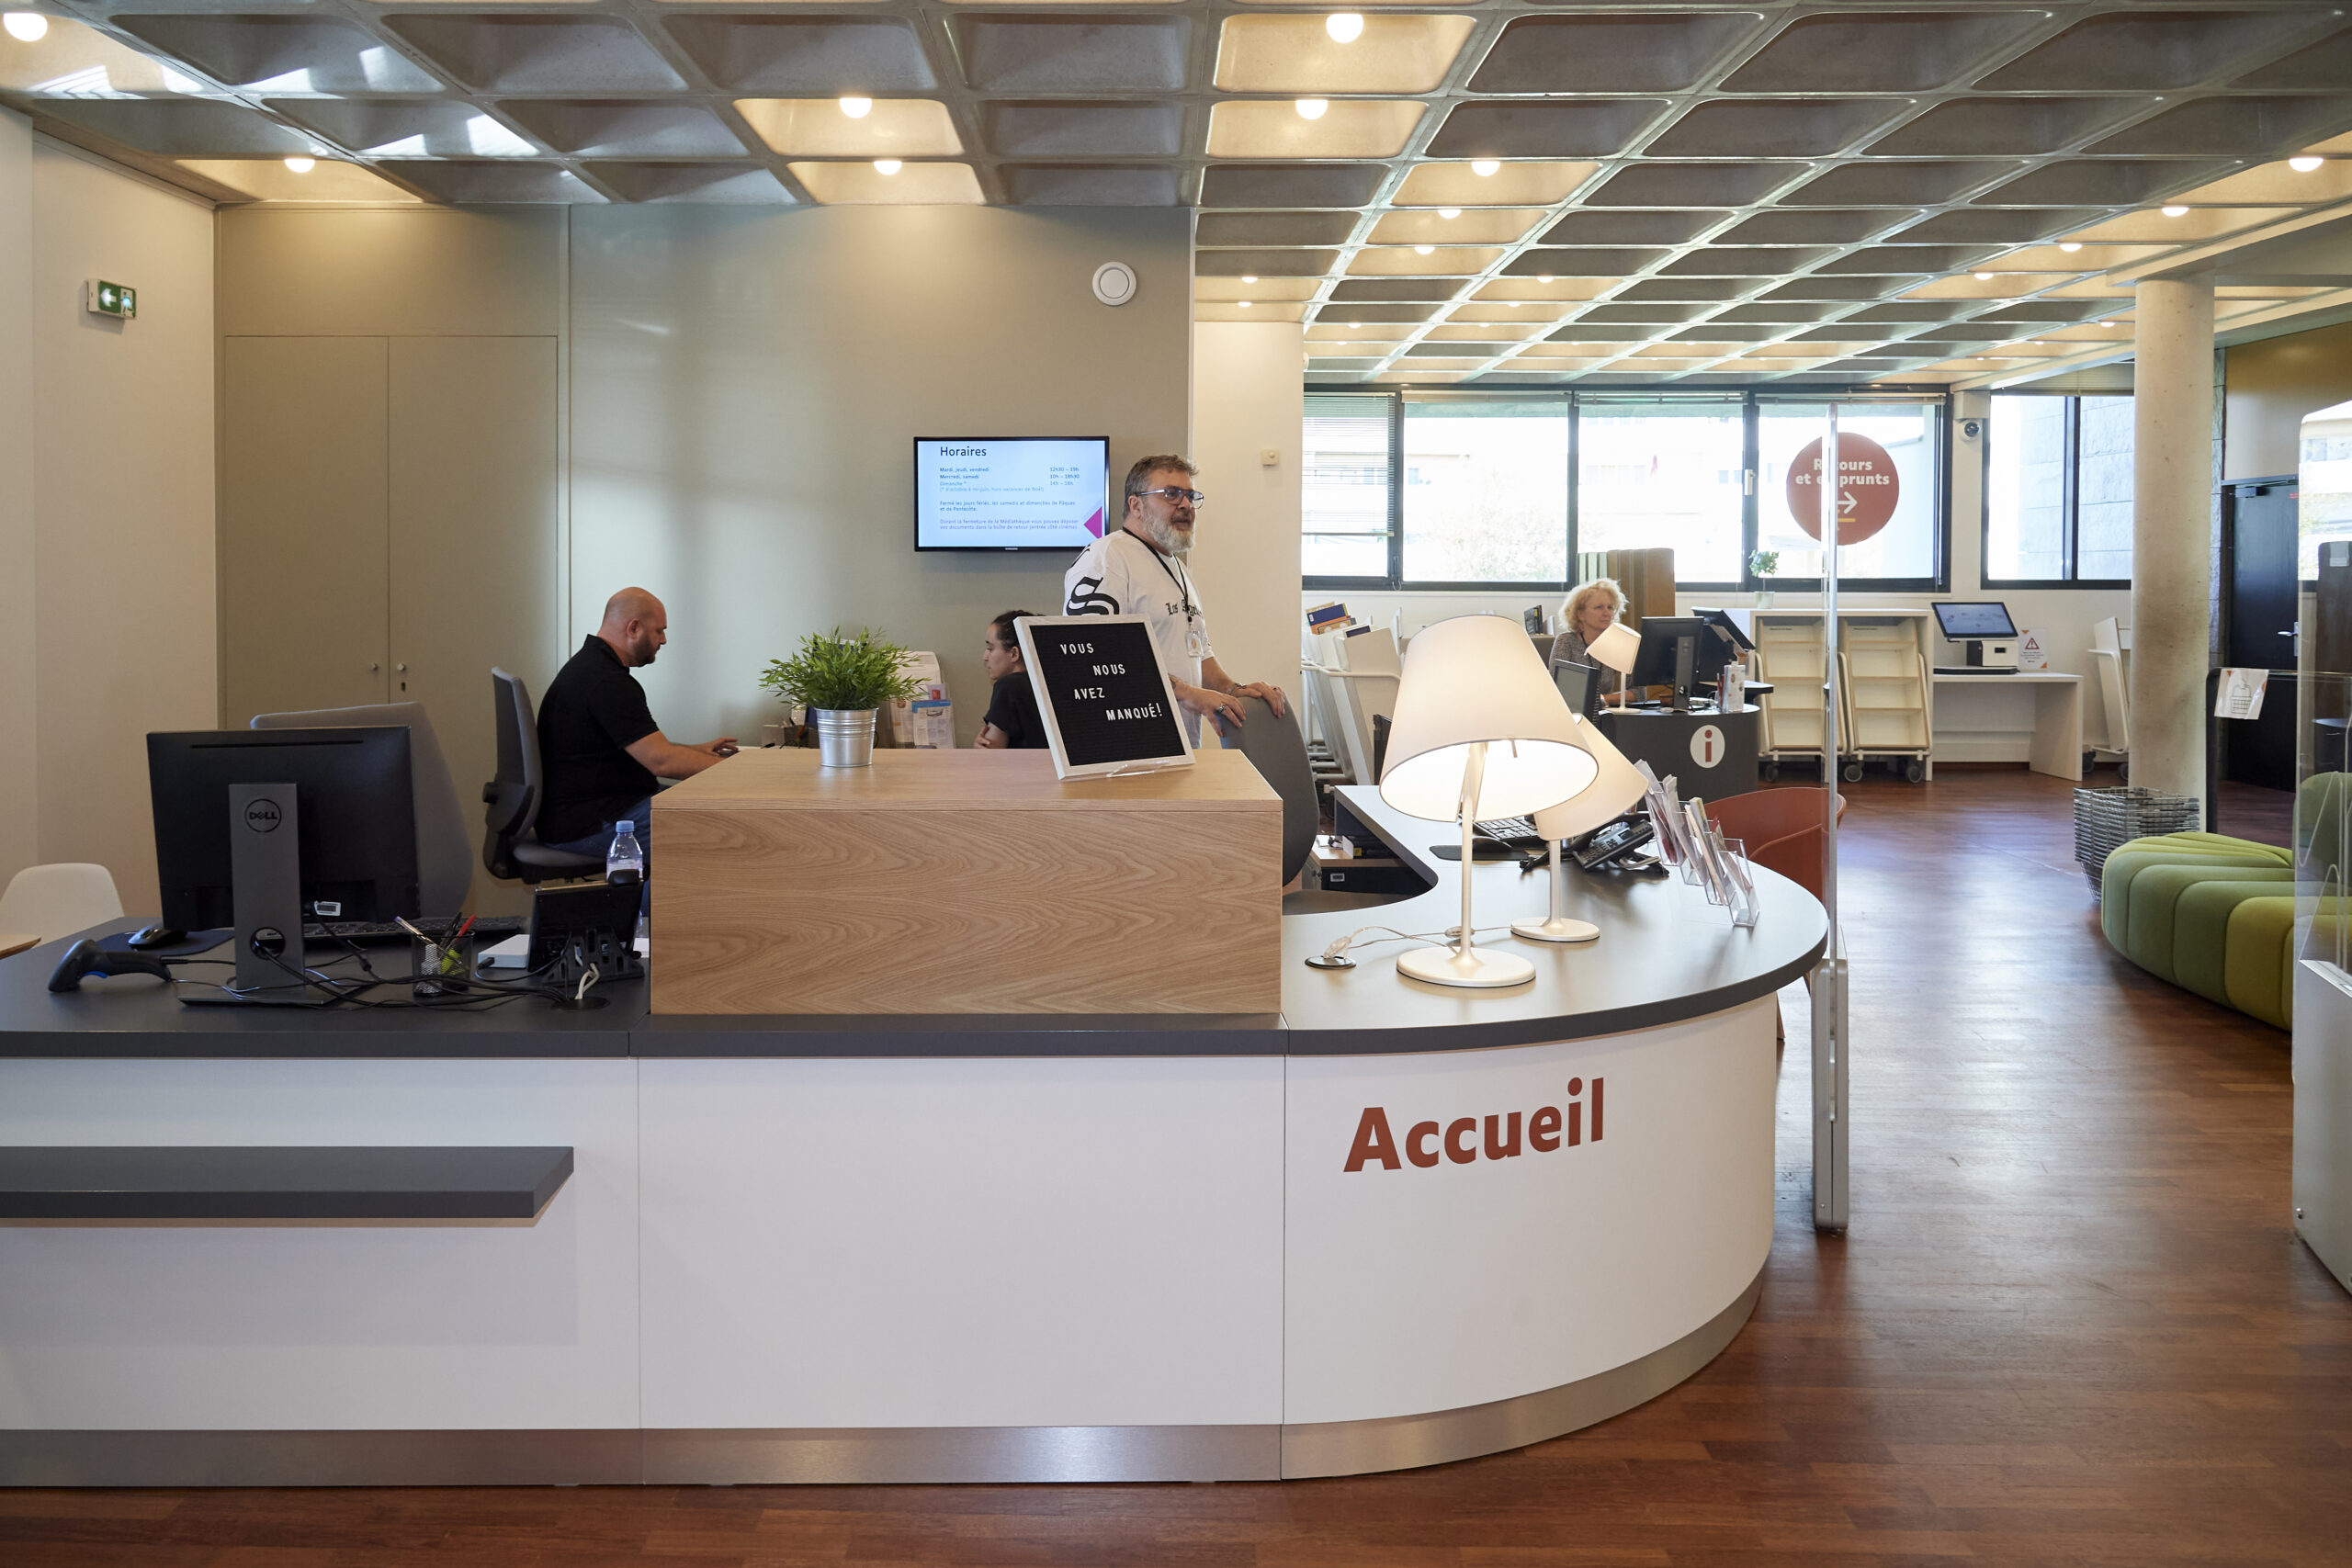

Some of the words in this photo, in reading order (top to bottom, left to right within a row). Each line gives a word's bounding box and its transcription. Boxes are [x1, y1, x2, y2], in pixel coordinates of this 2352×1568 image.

[940, 446, 987, 457] Horaires
[1814, 458, 1872, 470] Rours
[1795, 474, 1811, 485] et
[1816, 474, 1890, 488] eprunts
[1060, 643, 1094, 655] VOUS
[1093, 663, 1125, 676] NOUS
[1074, 687, 1105, 700] AVEZ
[1106, 703, 1162, 721] MANQUÉ!
[249, 811, 277, 820] DELL
[1343, 1077, 1604, 1172] Accueil
